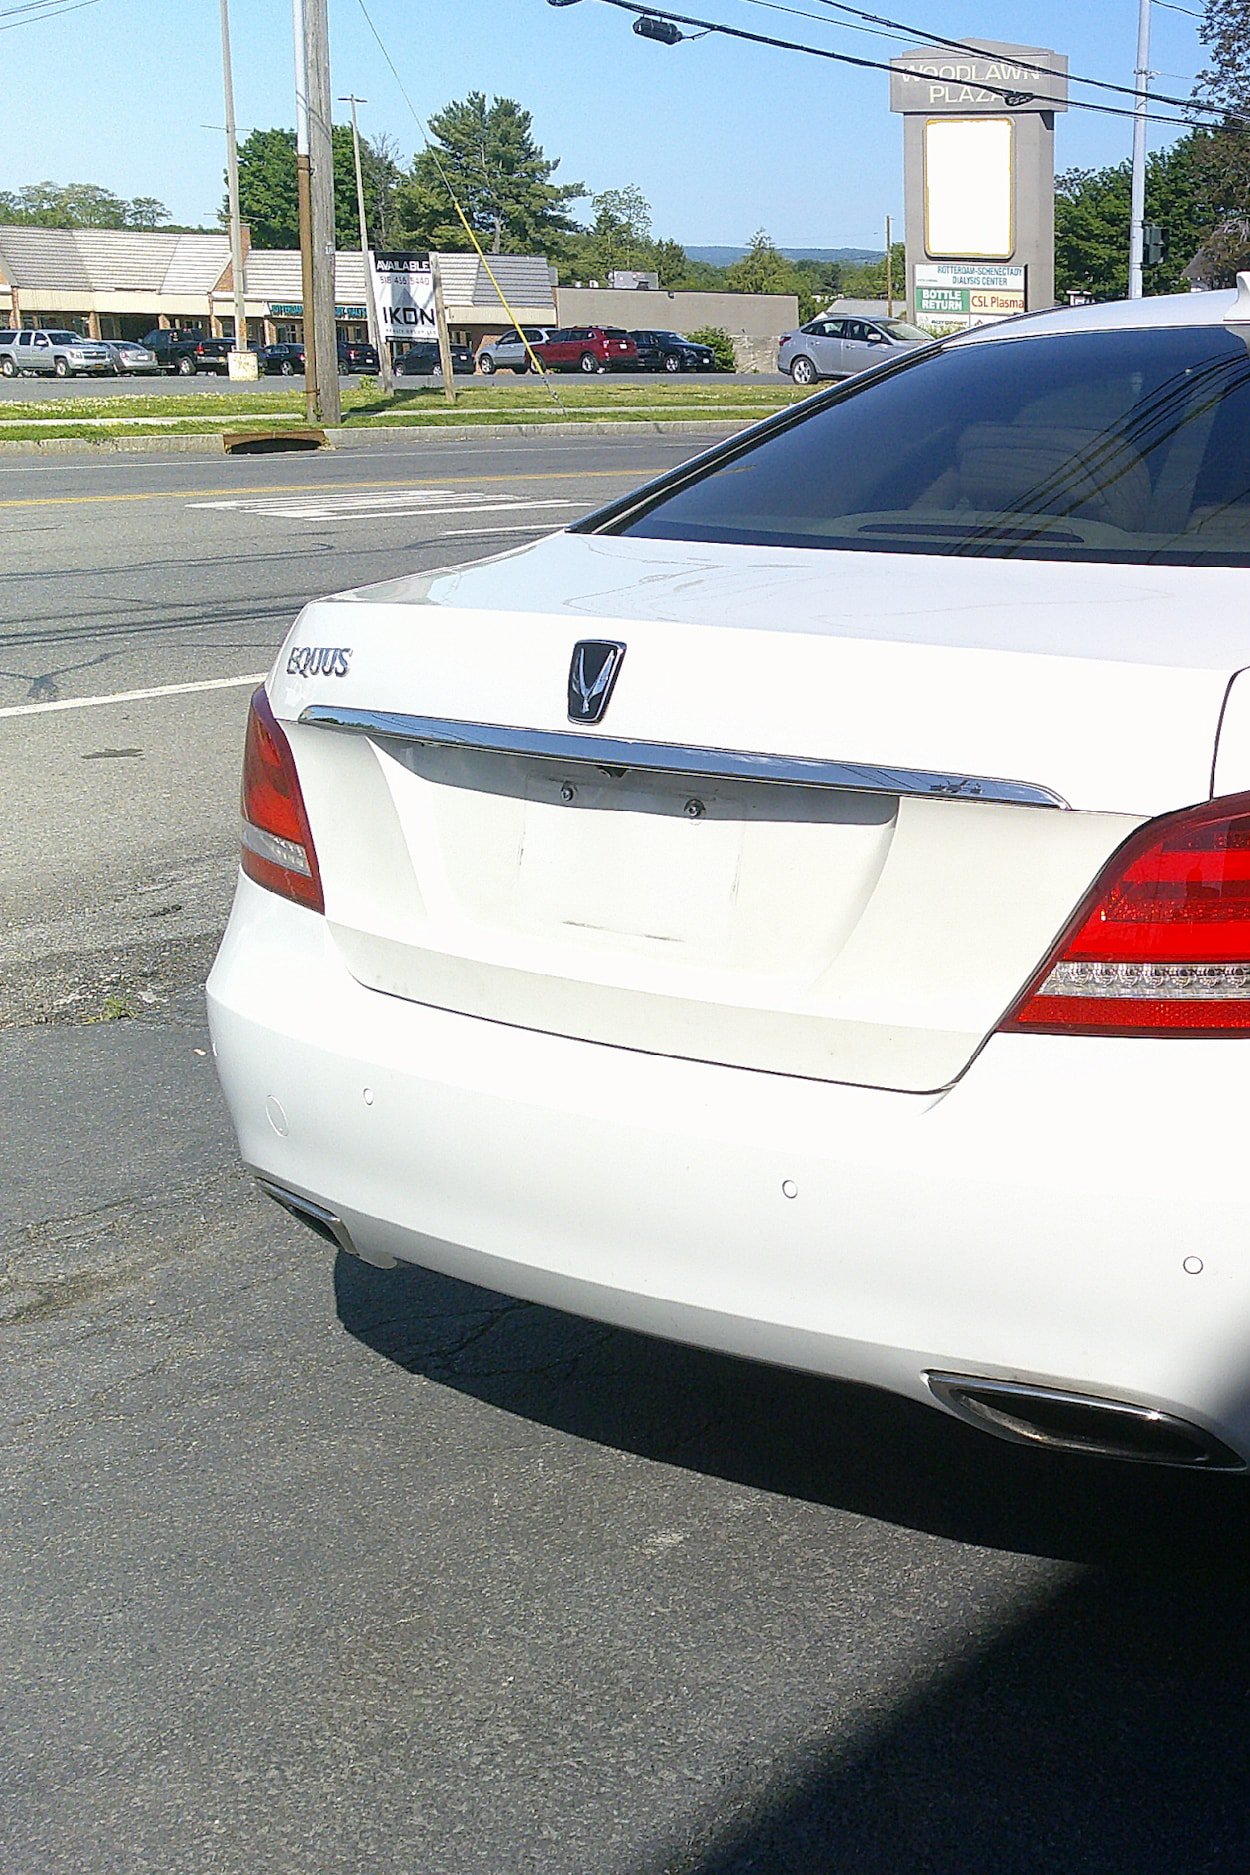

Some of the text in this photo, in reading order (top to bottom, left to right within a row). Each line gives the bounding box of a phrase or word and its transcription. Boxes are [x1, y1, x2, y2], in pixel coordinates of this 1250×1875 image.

[901, 63, 1041, 83] WOODLAWN
[376, 260, 431, 272] AVAILABLE
[937, 265, 1023, 277] ROTTERDAM-SCHENECTADY
[952, 275, 1008, 287] DIALYSIS CENTER
[922, 289, 962, 300] BOTTLE
[921, 300, 962, 311] RETURN
[971, 295, 1025, 309] CSL Plasma
[382, 306, 436, 326] IKON
[286, 646, 353, 679] EQUUS
